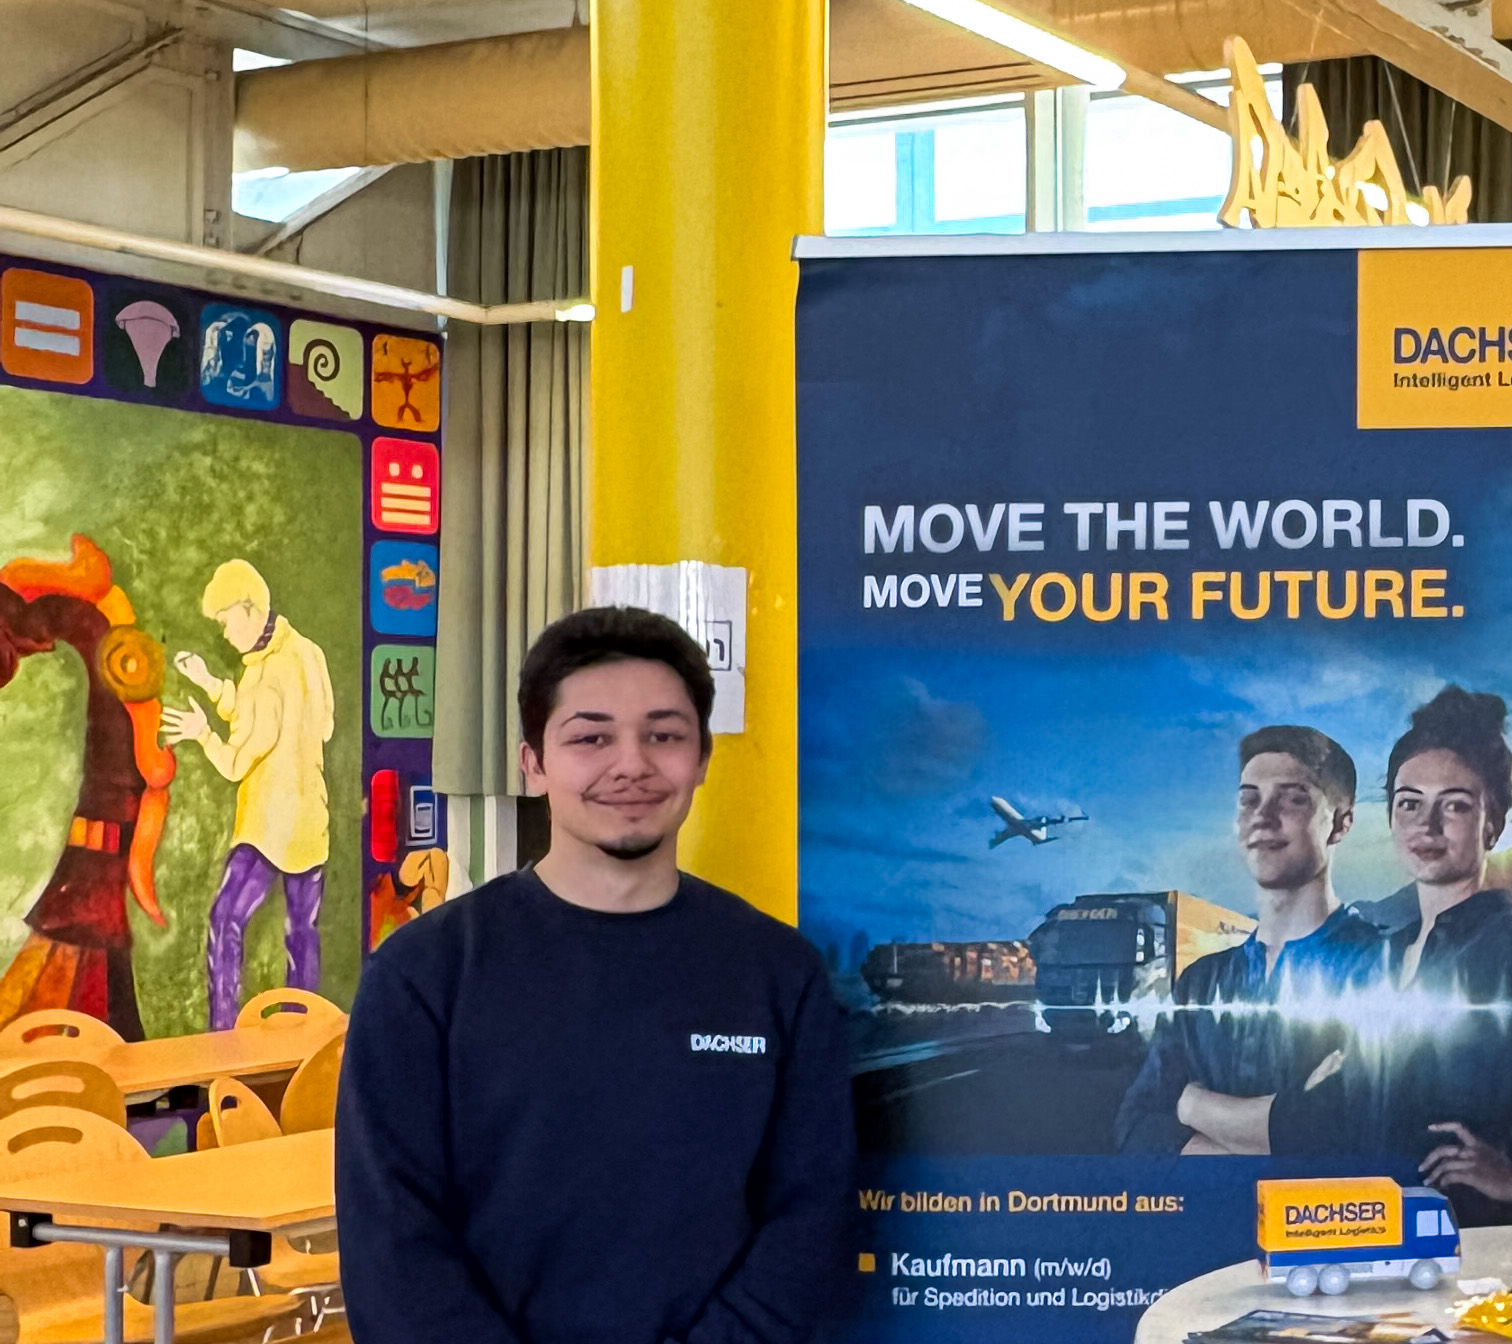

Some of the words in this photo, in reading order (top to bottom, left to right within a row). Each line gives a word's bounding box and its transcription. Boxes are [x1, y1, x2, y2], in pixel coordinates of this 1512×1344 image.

[1393, 372, 1491, 391] Intelligent
[864, 502, 1045, 554] MOVE
[1064, 501, 1190, 551] THE
[1208, 498, 1465, 549] WORLD.
[863, 573, 983, 608] MOVE
[989, 571, 1169, 622] YOUR
[1191, 569, 1465, 620] FUTURE.
[690, 1033, 766, 1054] DACHSER
[858, 1190, 895, 1212] Wir
[900, 1191, 973, 1213] bilden
[978, 1191, 1001, 1213] in
[1007, 1190, 1128, 1213] Dortmund
[1134, 1194, 1185, 1213] aus:
[1285, 1201, 1386, 1225] DACHSER
[892, 1252, 1026, 1277] Kaufmann
[1034, 1257, 1112, 1281] (m/w/d)
[892, 1287, 919, 1306] für
[924, 1286, 1021, 1310] Spedition
[1026, 1287, 1066, 1307] und
[1071, 1287, 1168, 1310] Logistikd
